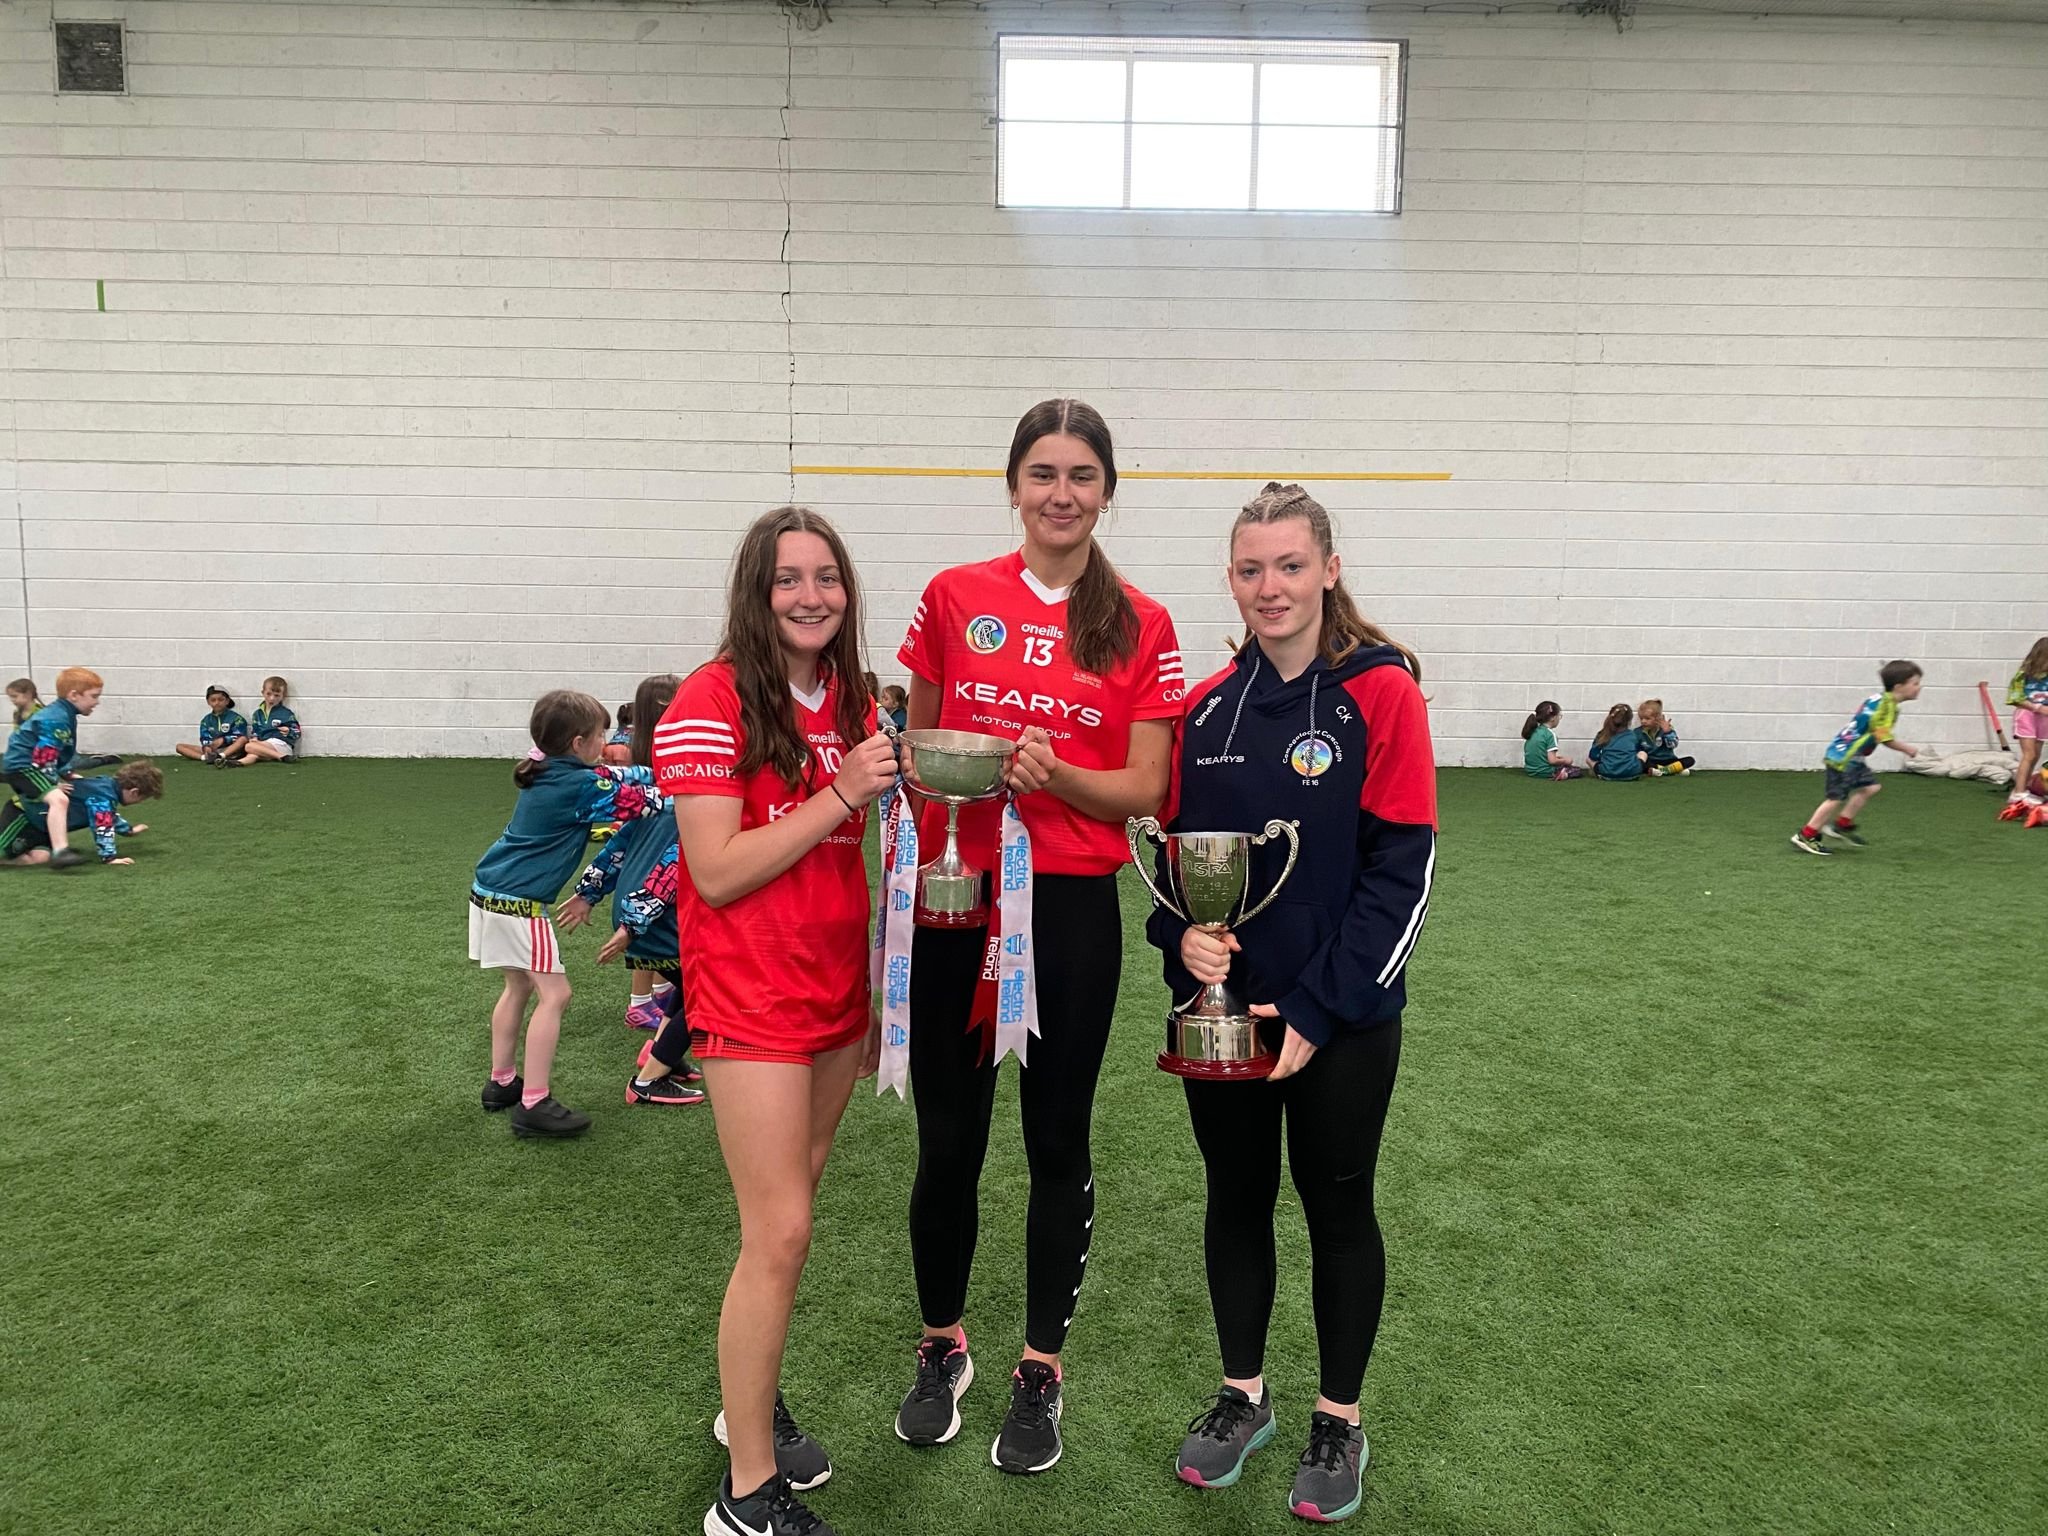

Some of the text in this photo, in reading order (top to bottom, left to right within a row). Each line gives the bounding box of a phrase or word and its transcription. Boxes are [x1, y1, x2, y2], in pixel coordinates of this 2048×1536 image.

[1023, 636, 1056, 667] 13
[955, 680, 1103, 727] KEARYS
[972, 714, 1022, 730] MOTOR
[816, 746, 844, 774] 10
[1196, 755, 1245, 766] KEARYS
[903, 819, 917, 867] Ireland
[1016, 835, 1029, 890] electric
[1003, 845, 1017, 891] Ireland
[897, 955, 910, 1004] Ireland
[982, 936, 1001, 981] Ireland
[887, 955, 899, 1010] electric
[1000, 979, 1014, 1024] Ireland
[1012, 969, 1025, 1023] electric
